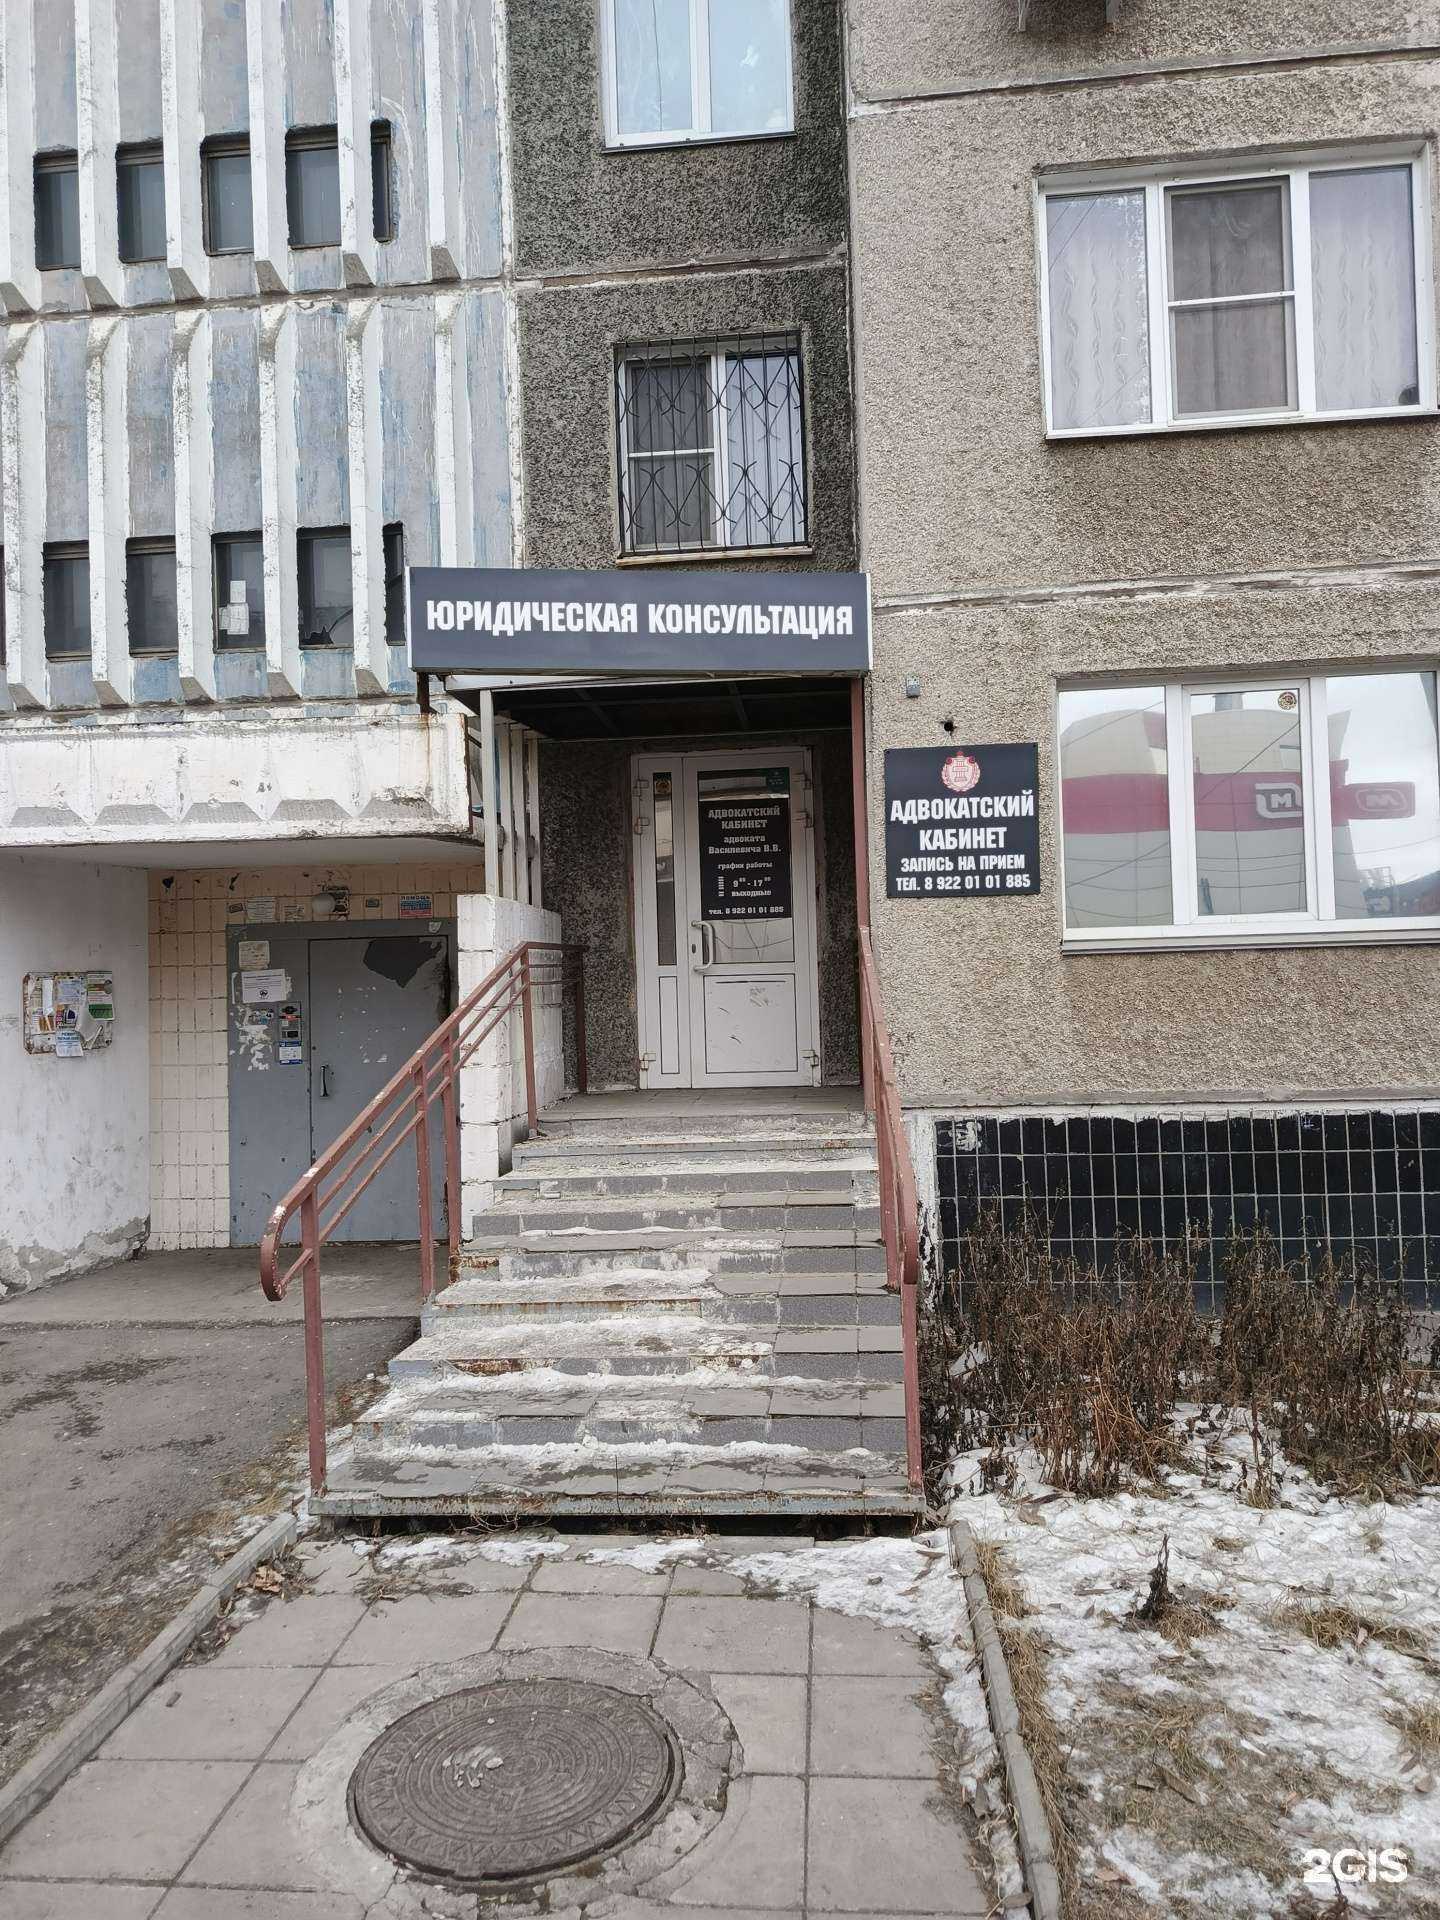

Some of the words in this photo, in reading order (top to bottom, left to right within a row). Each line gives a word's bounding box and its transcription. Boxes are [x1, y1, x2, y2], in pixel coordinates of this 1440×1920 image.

[426, 599, 639, 637] ЮРИДИЧЕСКАЯ
[648, 603, 854, 640] КОНСУЛЬТАЦИЯ
[708, 805, 780, 819] АДВОКАТСКИЙ
[890, 789, 1035, 825] АДВОКАТСКИЙ
[721, 819, 768, 829] КАБИНЕТ
[724, 835, 766, 844] адвоката
[919, 826, 1007, 851] КАБИНЕТ
[717, 862, 744, 870] график
[746, 861, 773, 869] работы
[900, 856, 954, 872] ЗАПИСЬ
[958, 855, 976, 871] НА
[980, 854, 1025, 871] ПРИЕМ
[896, 877, 921, 891] ТЕЛ.
[924, 876, 932, 890] 8
[936, 876, 961, 890] 922
[965, 875, 980, 889] 01
[985, 875, 1001, 889] 01
[1005, 874, 1031, 888] 885
[731, 889, 772, 898] выходные
